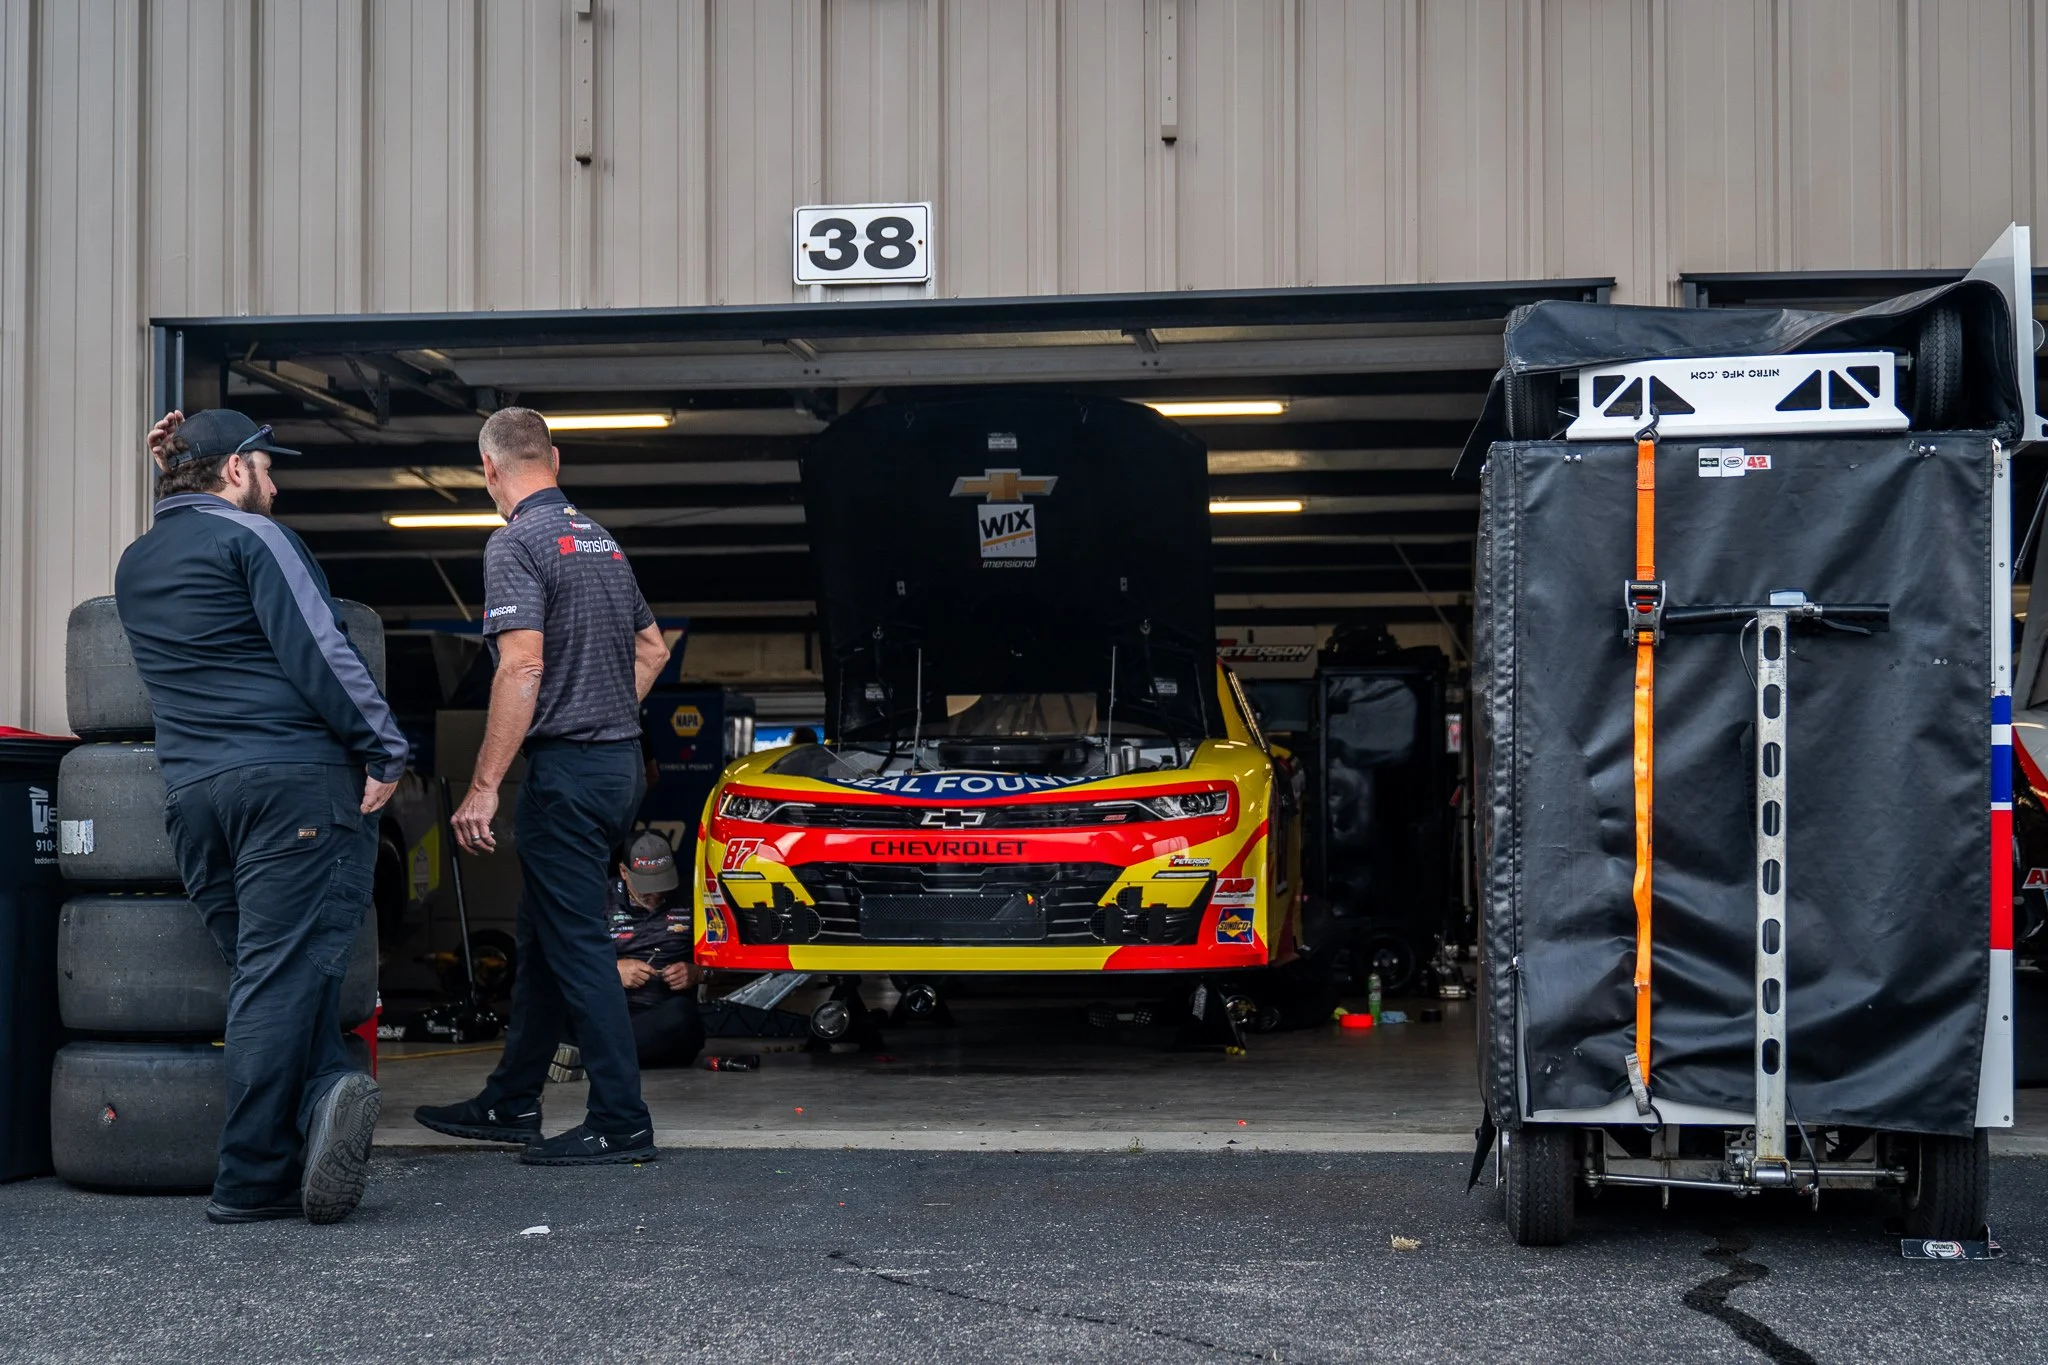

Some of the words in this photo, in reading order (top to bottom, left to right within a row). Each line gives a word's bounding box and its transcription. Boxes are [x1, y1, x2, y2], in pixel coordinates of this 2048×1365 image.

[808, 216, 917, 271] 38
[1721, 370, 1745, 379] MFG
[1748, 368, 1780, 378] NITRO
[1747, 456, 1768, 468] 42
[980, 508, 1033, 539] WIX
[489, 605, 518, 618] NASCAR
[675, 714, 699, 728] NAPA
[35, 839, 58, 852] 910-
[870, 840, 1028, 856] CHEVROLET
[722, 838, 765, 872] 87
[1173, 857, 1211, 865] PETERSON
[2022, 867, 2048, 889] A
[1218, 920, 1250, 931] SUNOCO
